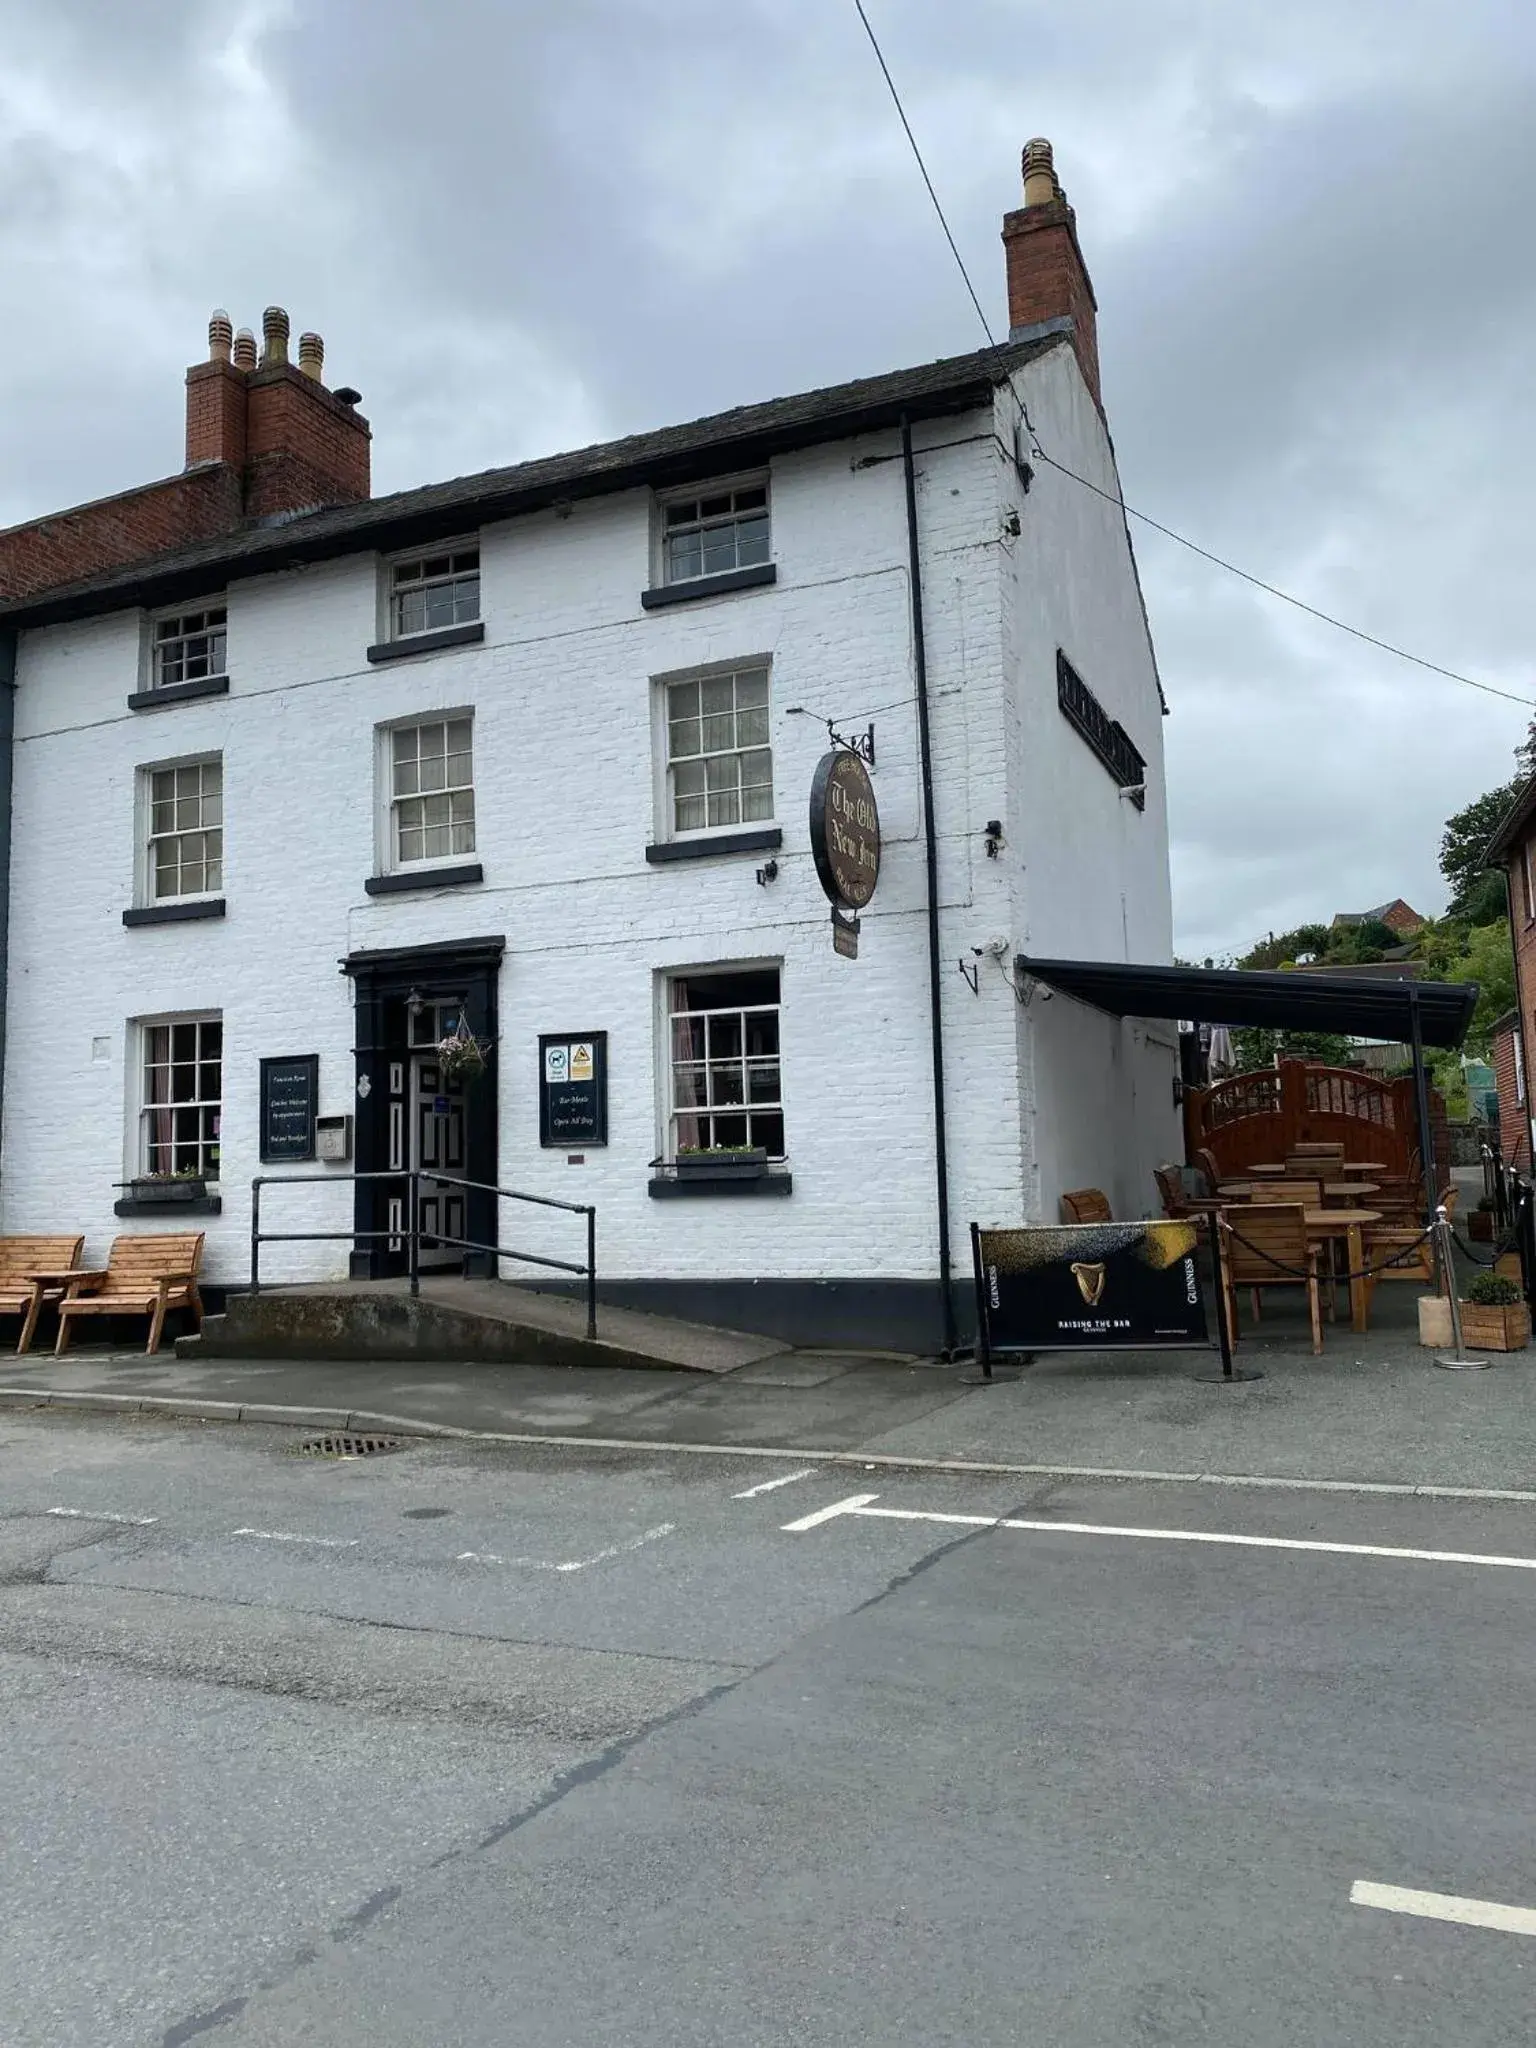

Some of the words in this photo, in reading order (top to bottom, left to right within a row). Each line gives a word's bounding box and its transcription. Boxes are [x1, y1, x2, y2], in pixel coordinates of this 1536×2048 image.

[832, 781, 854, 824] The
[857, 799, 876, 832] Old
[832, 819, 856, 858] New
[858, 836, 876, 869] Inn
[990, 1265, 1000, 1309] GUINNESS
[1185, 1258, 1198, 1304] GUINNESS
[1058, 1320, 1092, 1328] RAISING
[1095, 1320, 1111, 1328] THE
[1114, 1320, 1131, 1328] BAR
